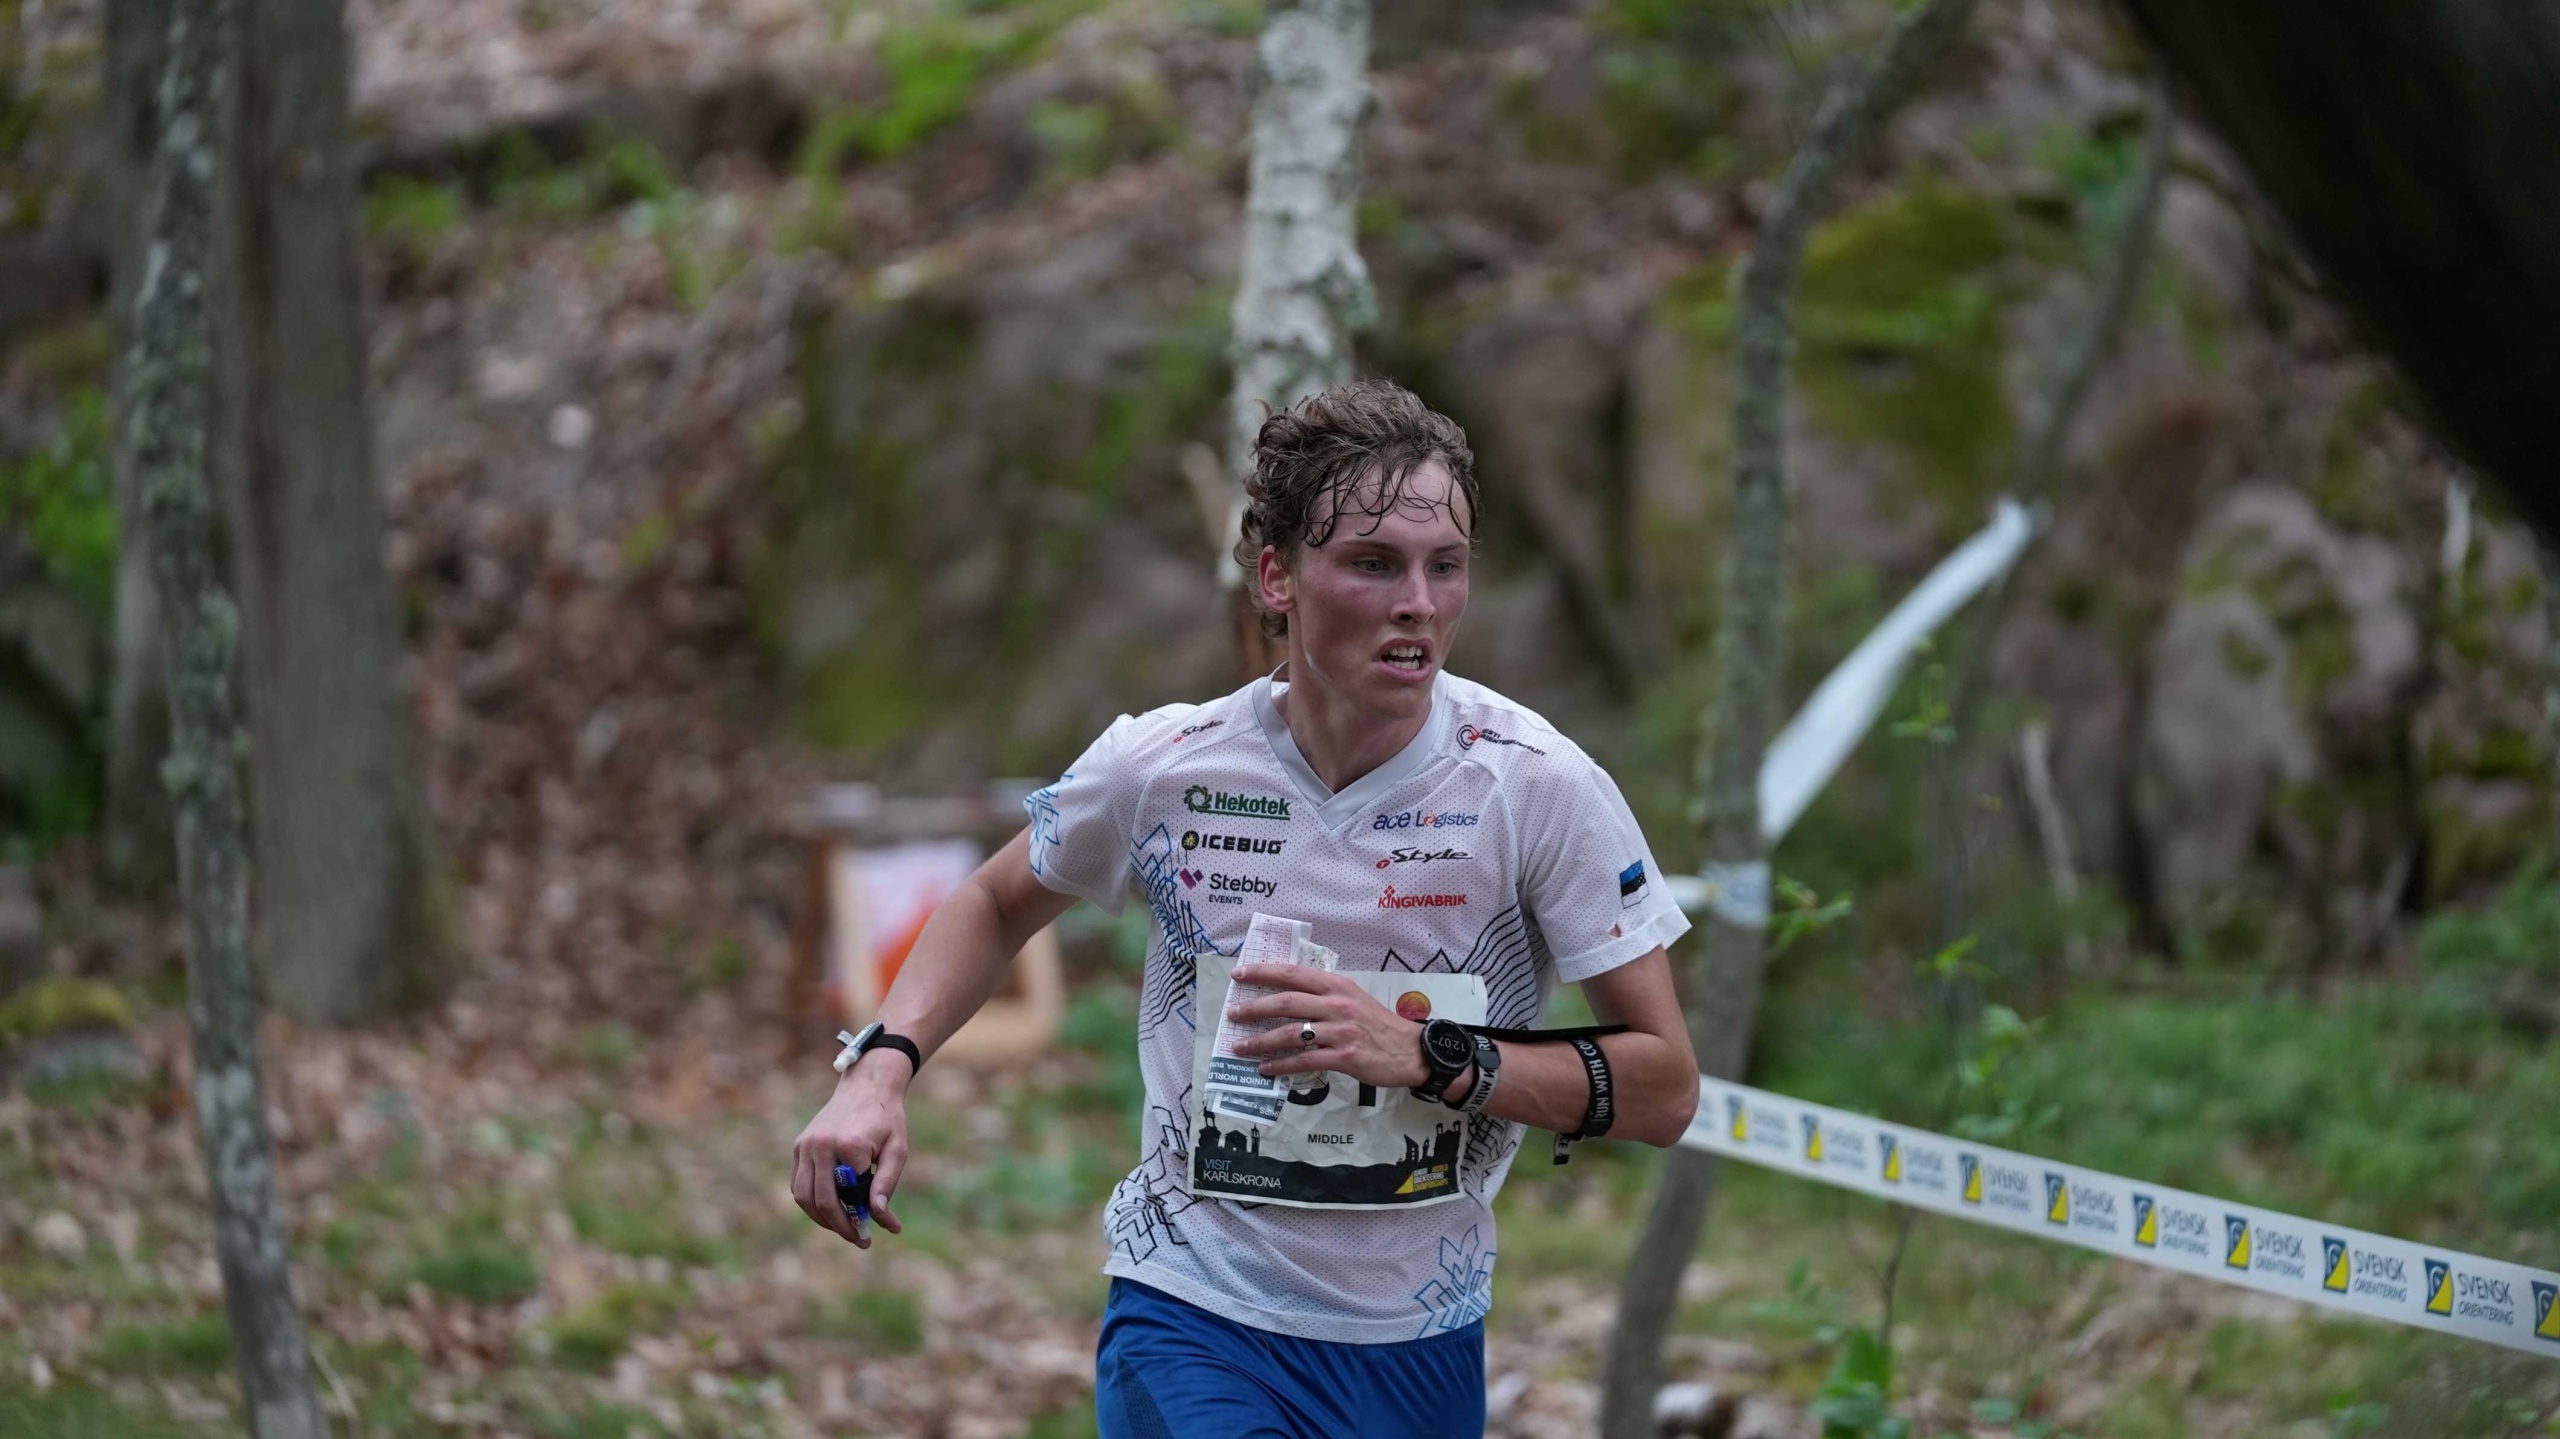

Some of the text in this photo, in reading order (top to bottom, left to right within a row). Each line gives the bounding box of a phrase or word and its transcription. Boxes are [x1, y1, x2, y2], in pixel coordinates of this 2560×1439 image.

[1214, 791, 1291, 816] Hekotek
[1373, 810, 1479, 830] ace Logistics
[1201, 834, 1283, 854] ICEBUG
[1389, 846, 1473, 864] Style
[1209, 873, 1278, 898] Stebby
[1208, 894, 1243, 905] EVENTS
[1378, 893, 1468, 909] KINGIVABRIK
[1207, 1072, 1272, 1087] JUNIOR WORLD
[1589, 1059, 1608, 1094] WITH
[1307, 1133, 1355, 1145] MIDDLE
[1204, 1158, 1232, 1171] VISIT
[2161, 1206, 2209, 1237] SVENSK
[2255, 1227, 2306, 1260] SVENSK
[2354, 1250, 2408, 1283] SVENSK
[2355, 1278, 2407, 1303] ORIENTERING
[2458, 1272, 2515, 1306] SVENSK
[2459, 1301, 2515, 1327] ORIENTERING
